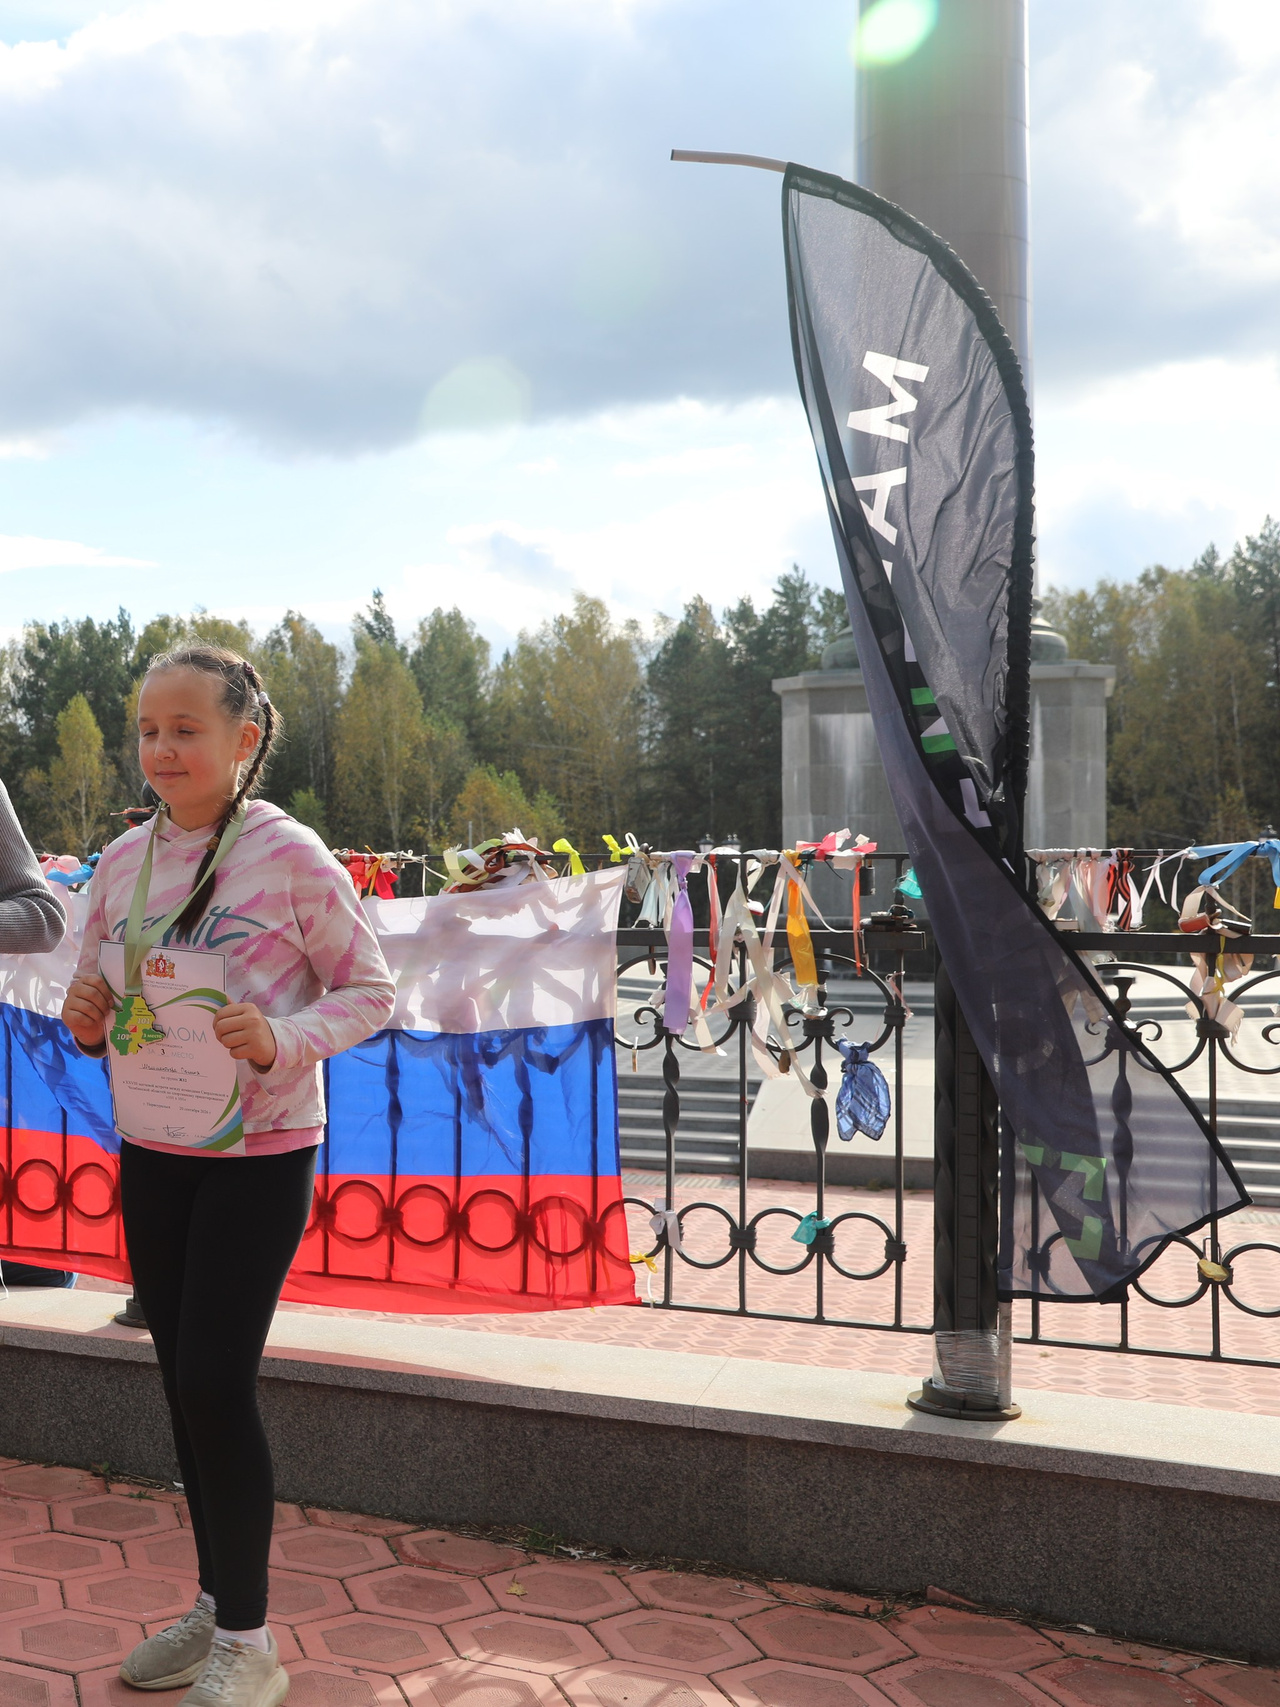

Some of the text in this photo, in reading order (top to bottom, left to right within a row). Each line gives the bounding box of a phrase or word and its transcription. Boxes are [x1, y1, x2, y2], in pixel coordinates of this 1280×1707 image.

[154, 1024, 208, 1044] ПЛОМ
[161, 1048, 166, 1056] 3
[171, 1051, 195, 1060] МЕСТО
